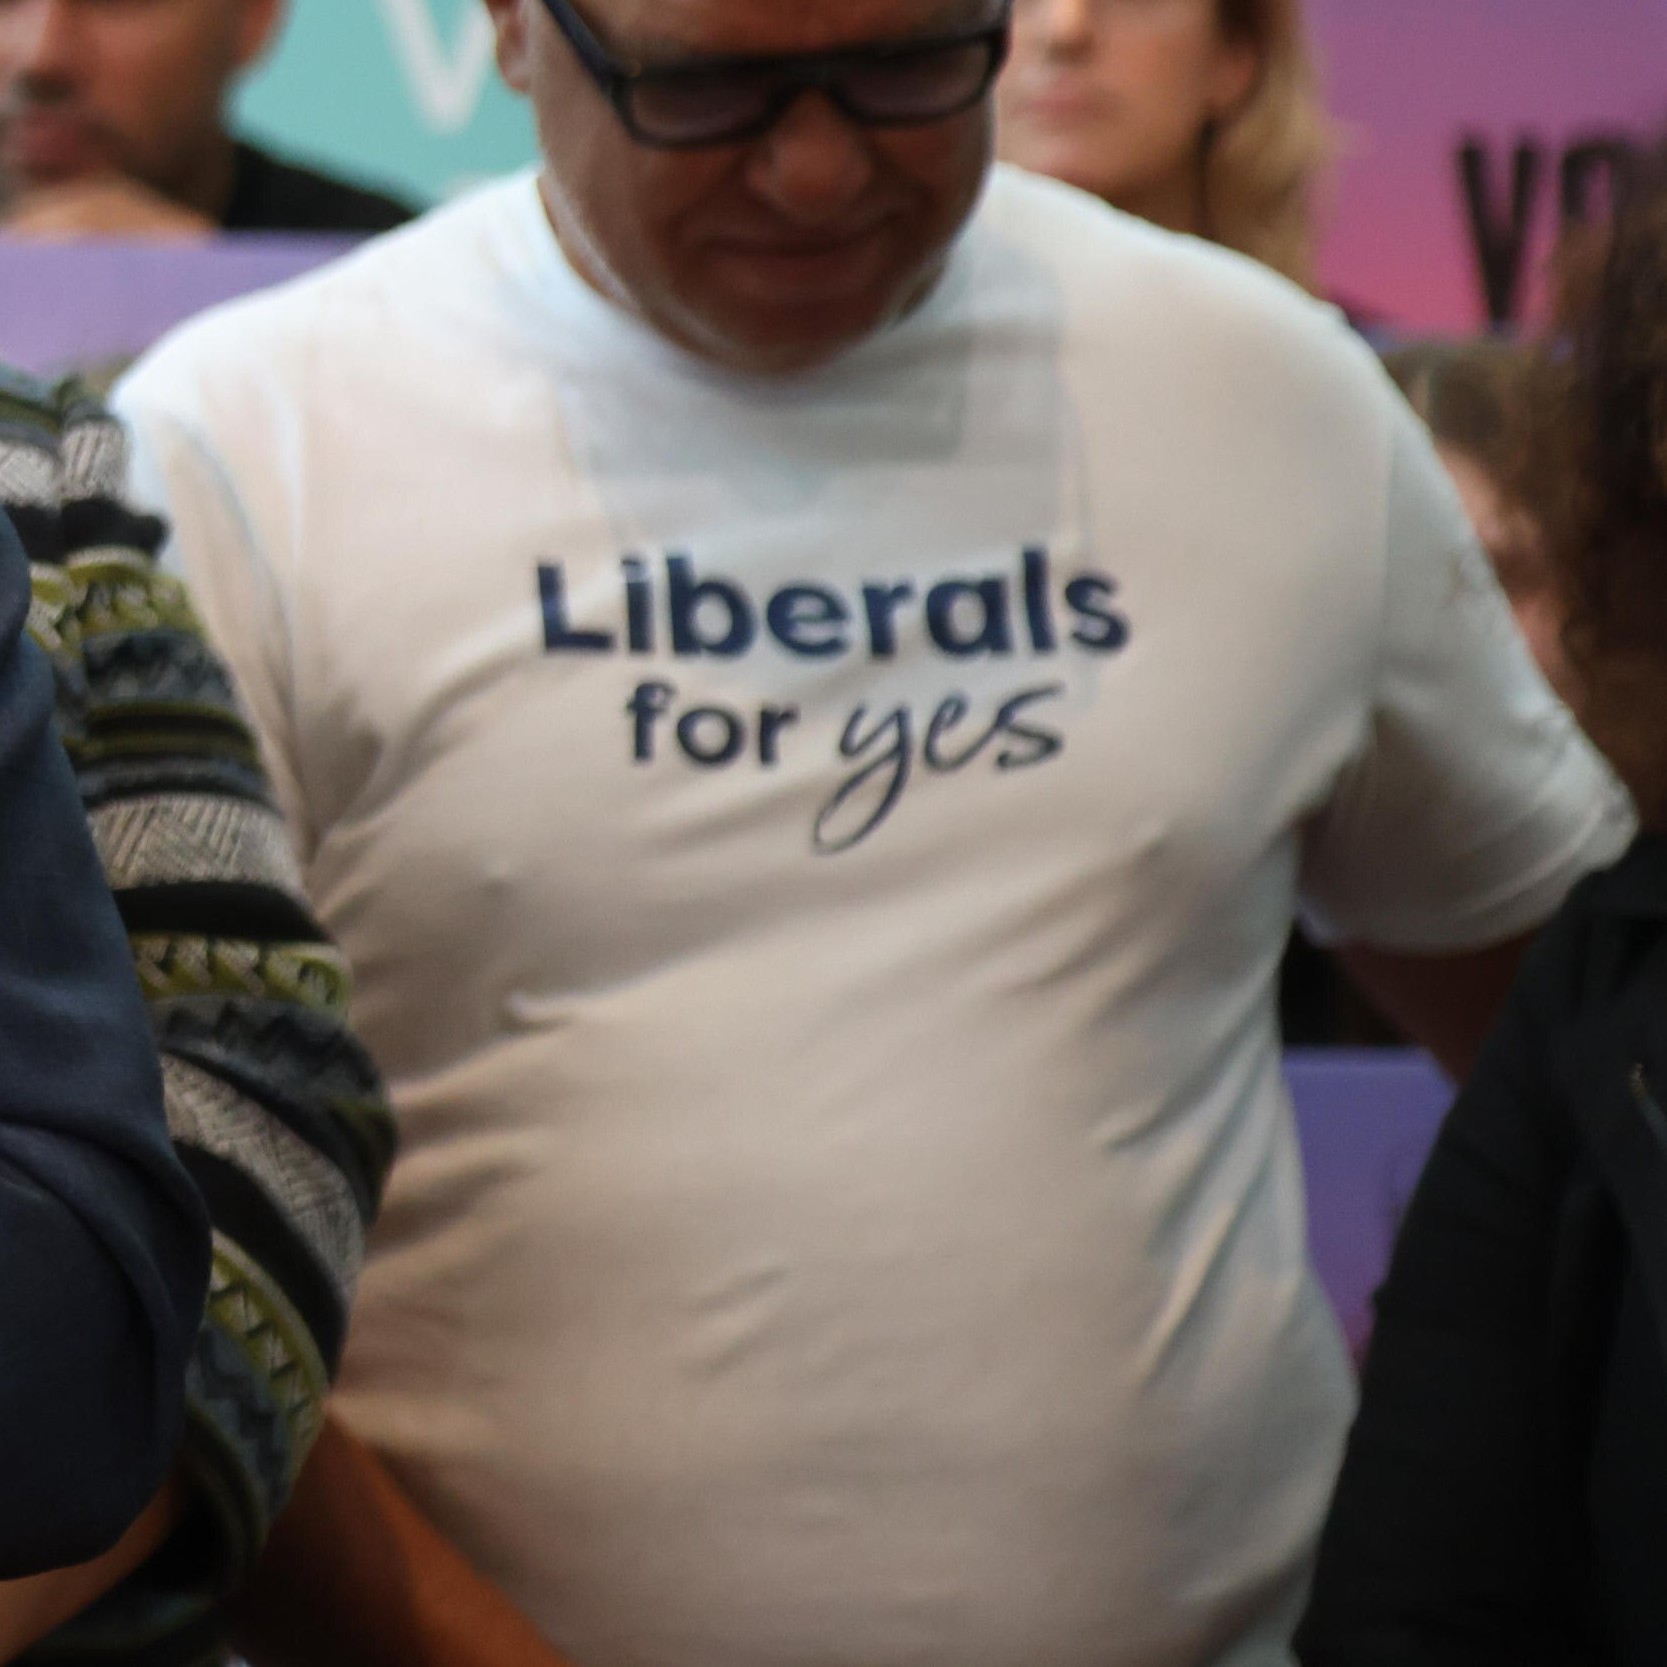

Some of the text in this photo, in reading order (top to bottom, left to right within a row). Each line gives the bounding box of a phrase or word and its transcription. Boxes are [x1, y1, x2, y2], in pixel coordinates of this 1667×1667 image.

[536, 544, 1131, 661] Liberals
[625, 678, 1067, 856] for yes
